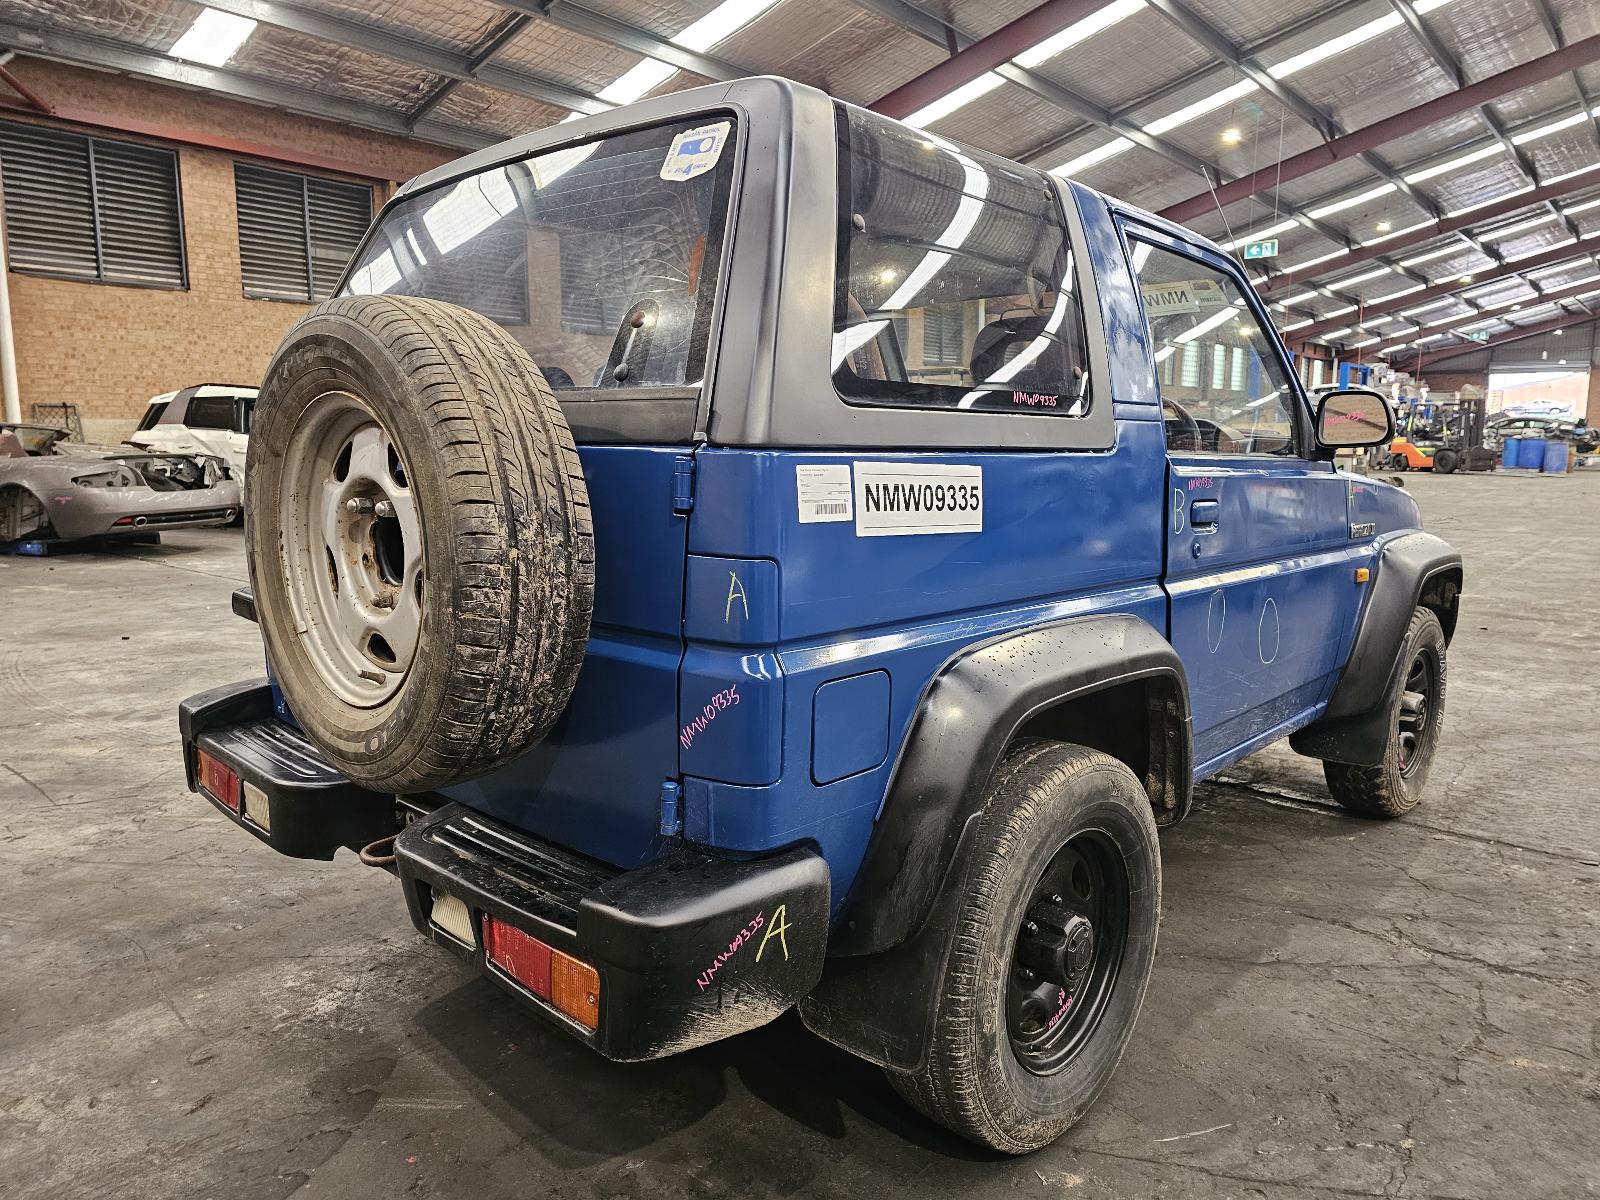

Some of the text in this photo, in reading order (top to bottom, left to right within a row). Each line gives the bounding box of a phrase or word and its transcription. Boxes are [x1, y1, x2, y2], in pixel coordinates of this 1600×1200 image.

[1013, 390, 1059, 407] NMW09335
[864, 483, 980, 512] NMW09335
[725, 570, 749, 624] A
[755, 904, 793, 963] A
